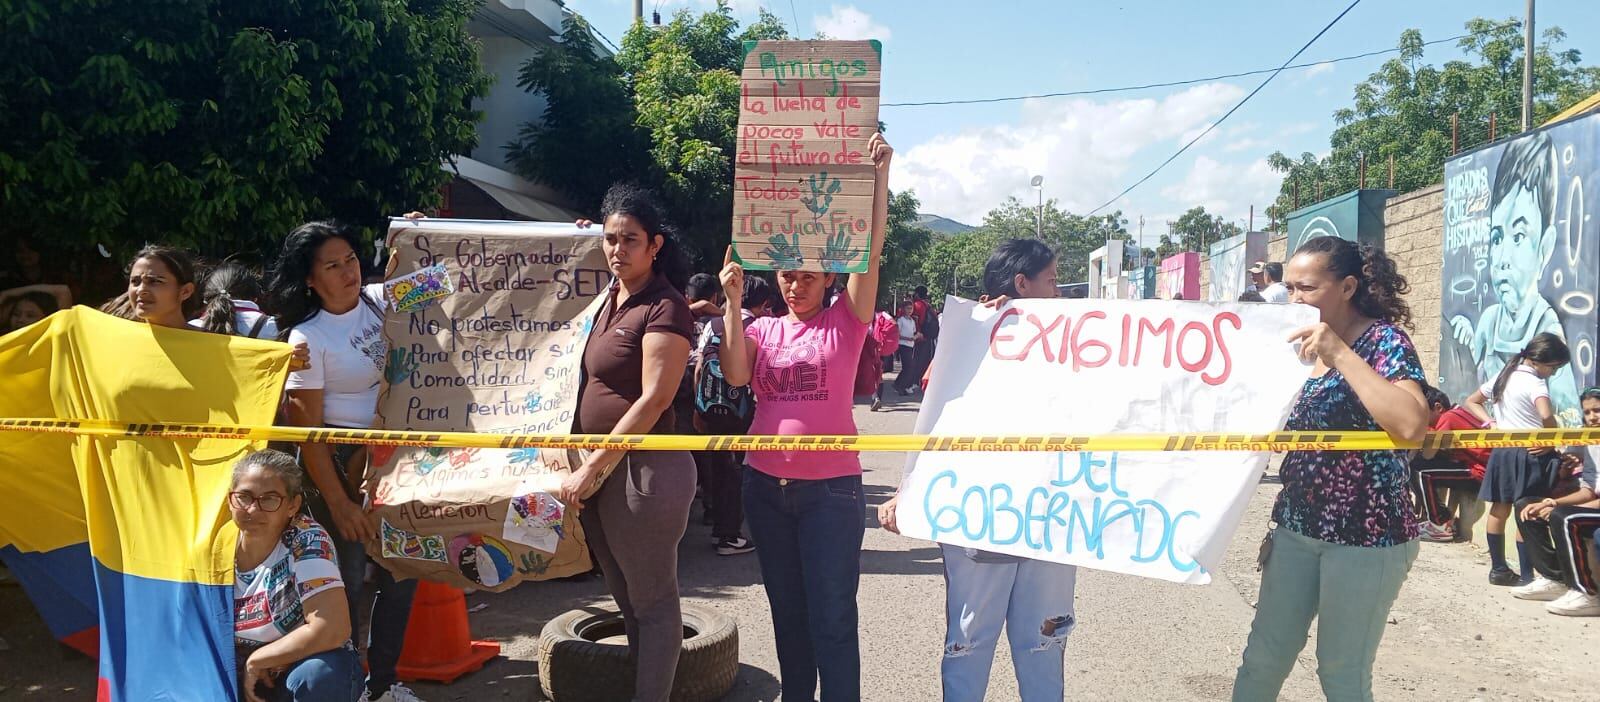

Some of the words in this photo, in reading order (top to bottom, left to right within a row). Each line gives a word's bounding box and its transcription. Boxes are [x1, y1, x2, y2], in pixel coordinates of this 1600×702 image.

[758, 52, 867, 97] Amigos
[836, 82, 861, 110] de
[743, 124, 804, 150] pocos
[739, 140, 758, 165] el
[769, 140, 831, 176] futuro
[834, 144, 862, 165] de
[736, 176, 801, 201] Todos
[780, 209, 829, 236] Juan
[1447, 199, 1466, 227] QUE
[413, 235, 444, 267] Sr
[409, 309, 440, 336] No
[451, 303, 571, 352] protestamos
[461, 335, 538, 369] afectar
[549, 344, 574, 357] su
[989, 308, 1242, 386] EXIGIMOS
[951, 444, 1013, 452] PELIGRO
[1019, 444, 1039, 452] NO
[1045, 443, 1083, 452] PASE
[1194, 443, 1262, 451] PELIGRO
[1267, 443, 1290, 453] NO
[1296, 442, 1336, 451] PASE
[1050, 451, 1128, 498] DEL
